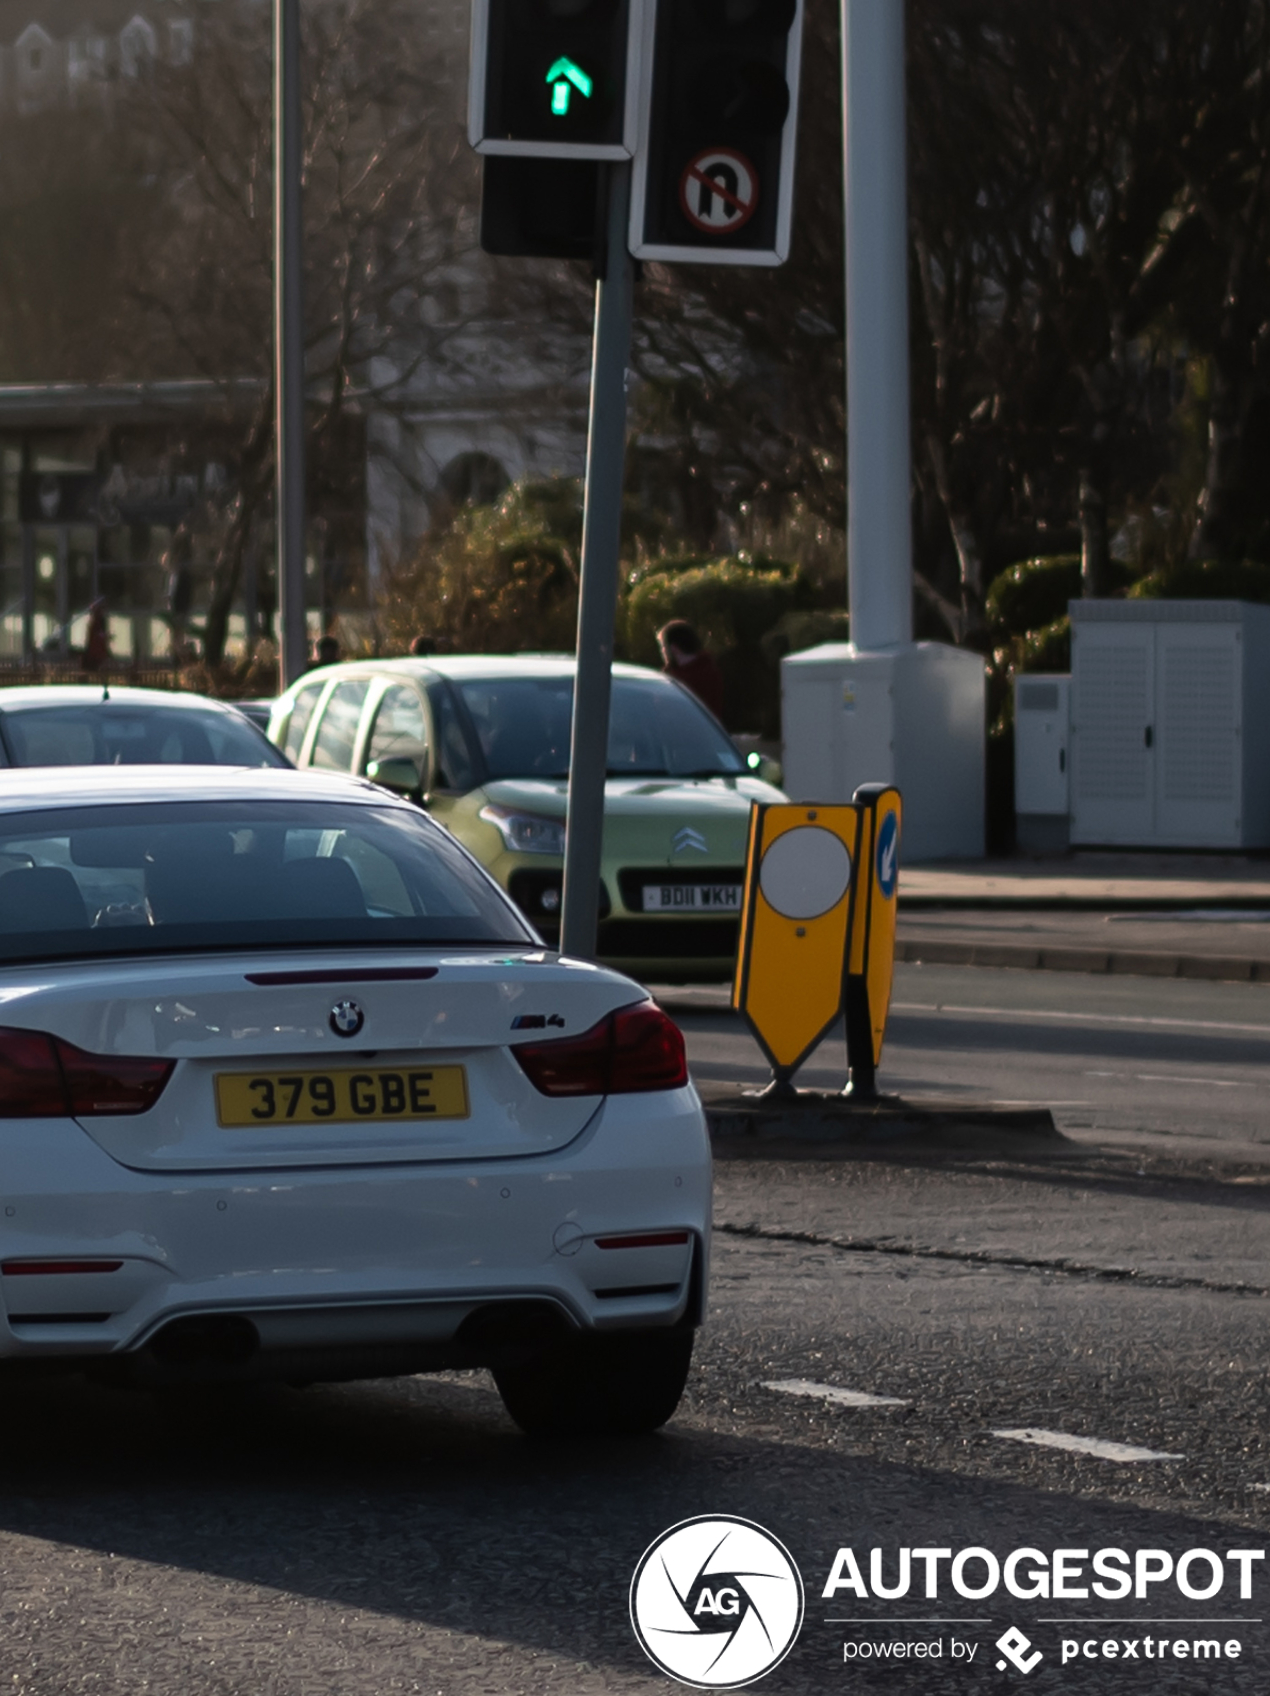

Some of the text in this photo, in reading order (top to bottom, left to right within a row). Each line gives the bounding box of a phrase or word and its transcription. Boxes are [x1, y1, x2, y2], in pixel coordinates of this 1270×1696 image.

[660, 886, 737, 906] BD11 WKH
[249, 1072, 436, 1119] 379 GBE
